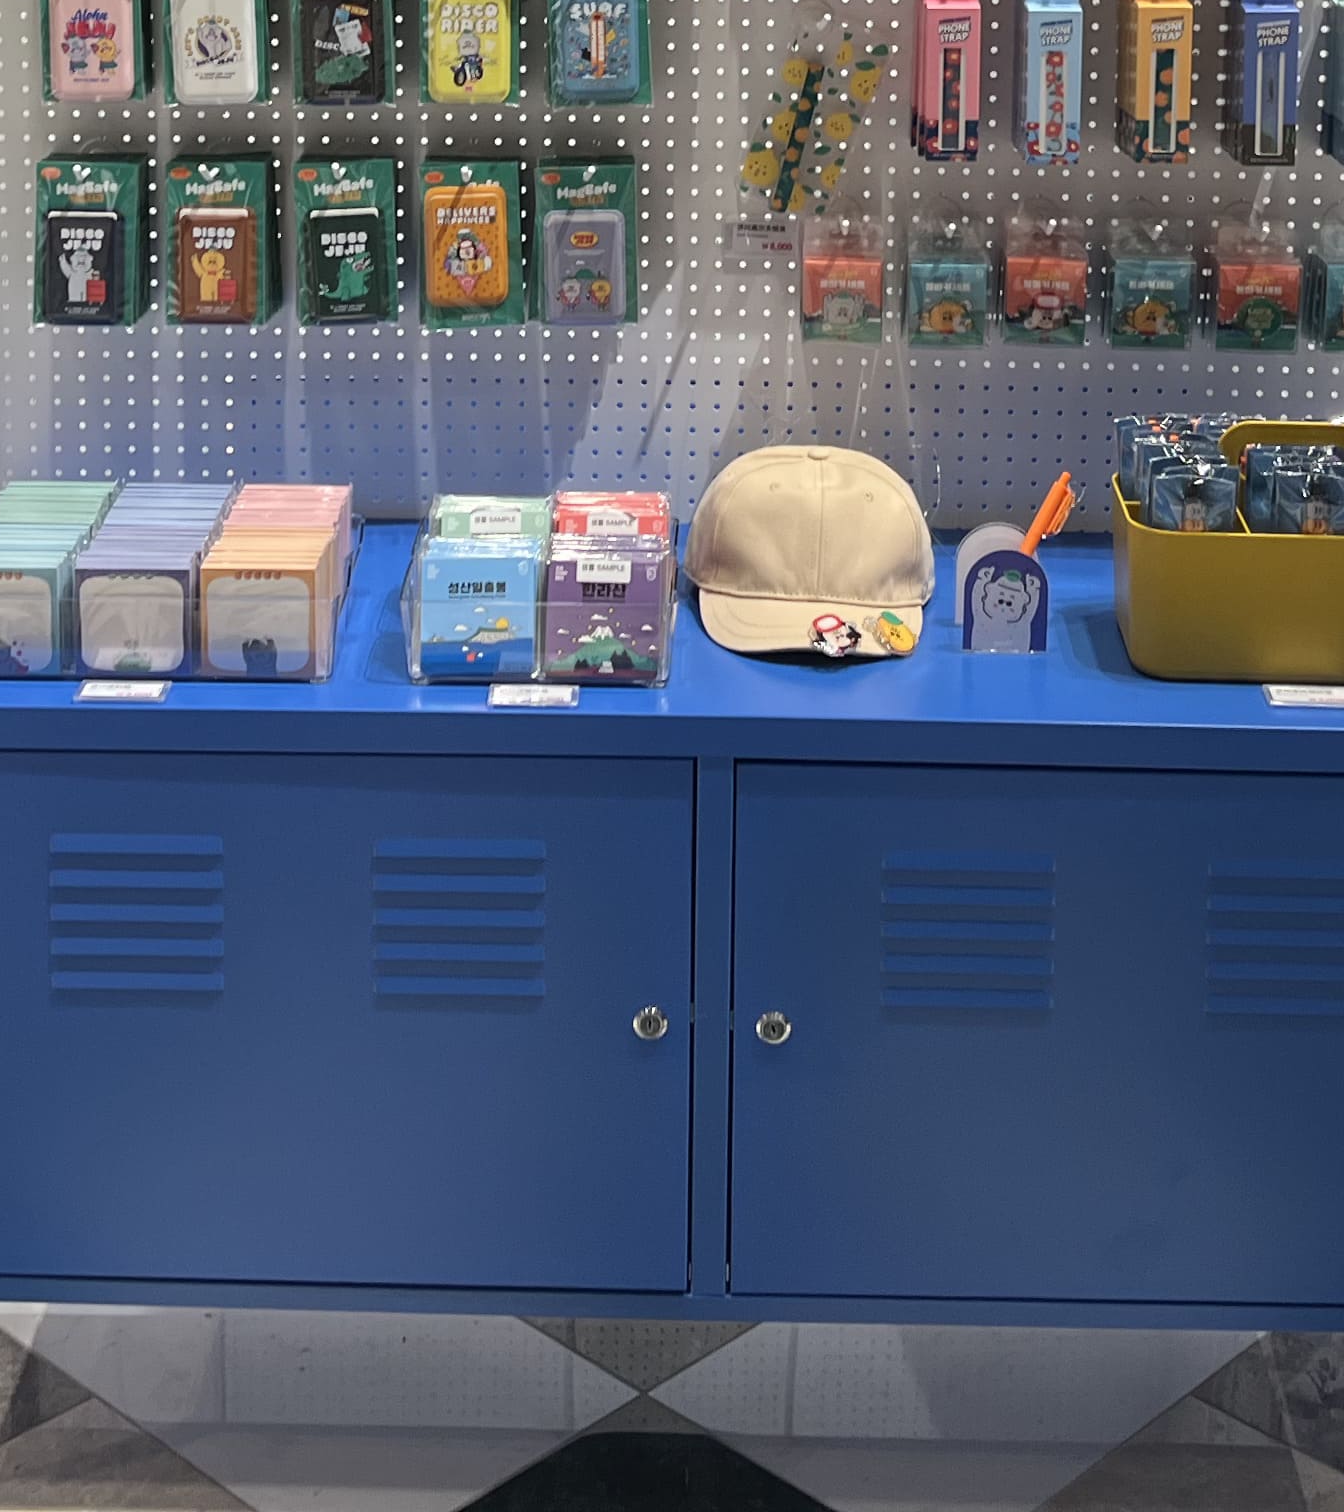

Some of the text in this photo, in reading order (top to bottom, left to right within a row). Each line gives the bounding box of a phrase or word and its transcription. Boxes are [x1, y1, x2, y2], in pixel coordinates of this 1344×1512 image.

[440, 3, 499, 19] DISCO
[938, 20, 972, 36] PHONE
[1040, 23, 1073, 38] PHONE
[1151, 21, 1184, 35] PHONE
[1257, 25, 1290, 39] PHONE
[940, 30, 969, 44] STRAP
[1040, 33, 1070, 46] STRAP
[1152, 30, 1182, 43] STRAP
[1258, 34, 1288, 48] STRAP
[489, 515, 517, 524] SAMPLE
[605, 518, 634, 528] SAMPLE
[596, 563, 626, 573] SAMPLE
[448, 581, 507, 595] 성산일출봉
